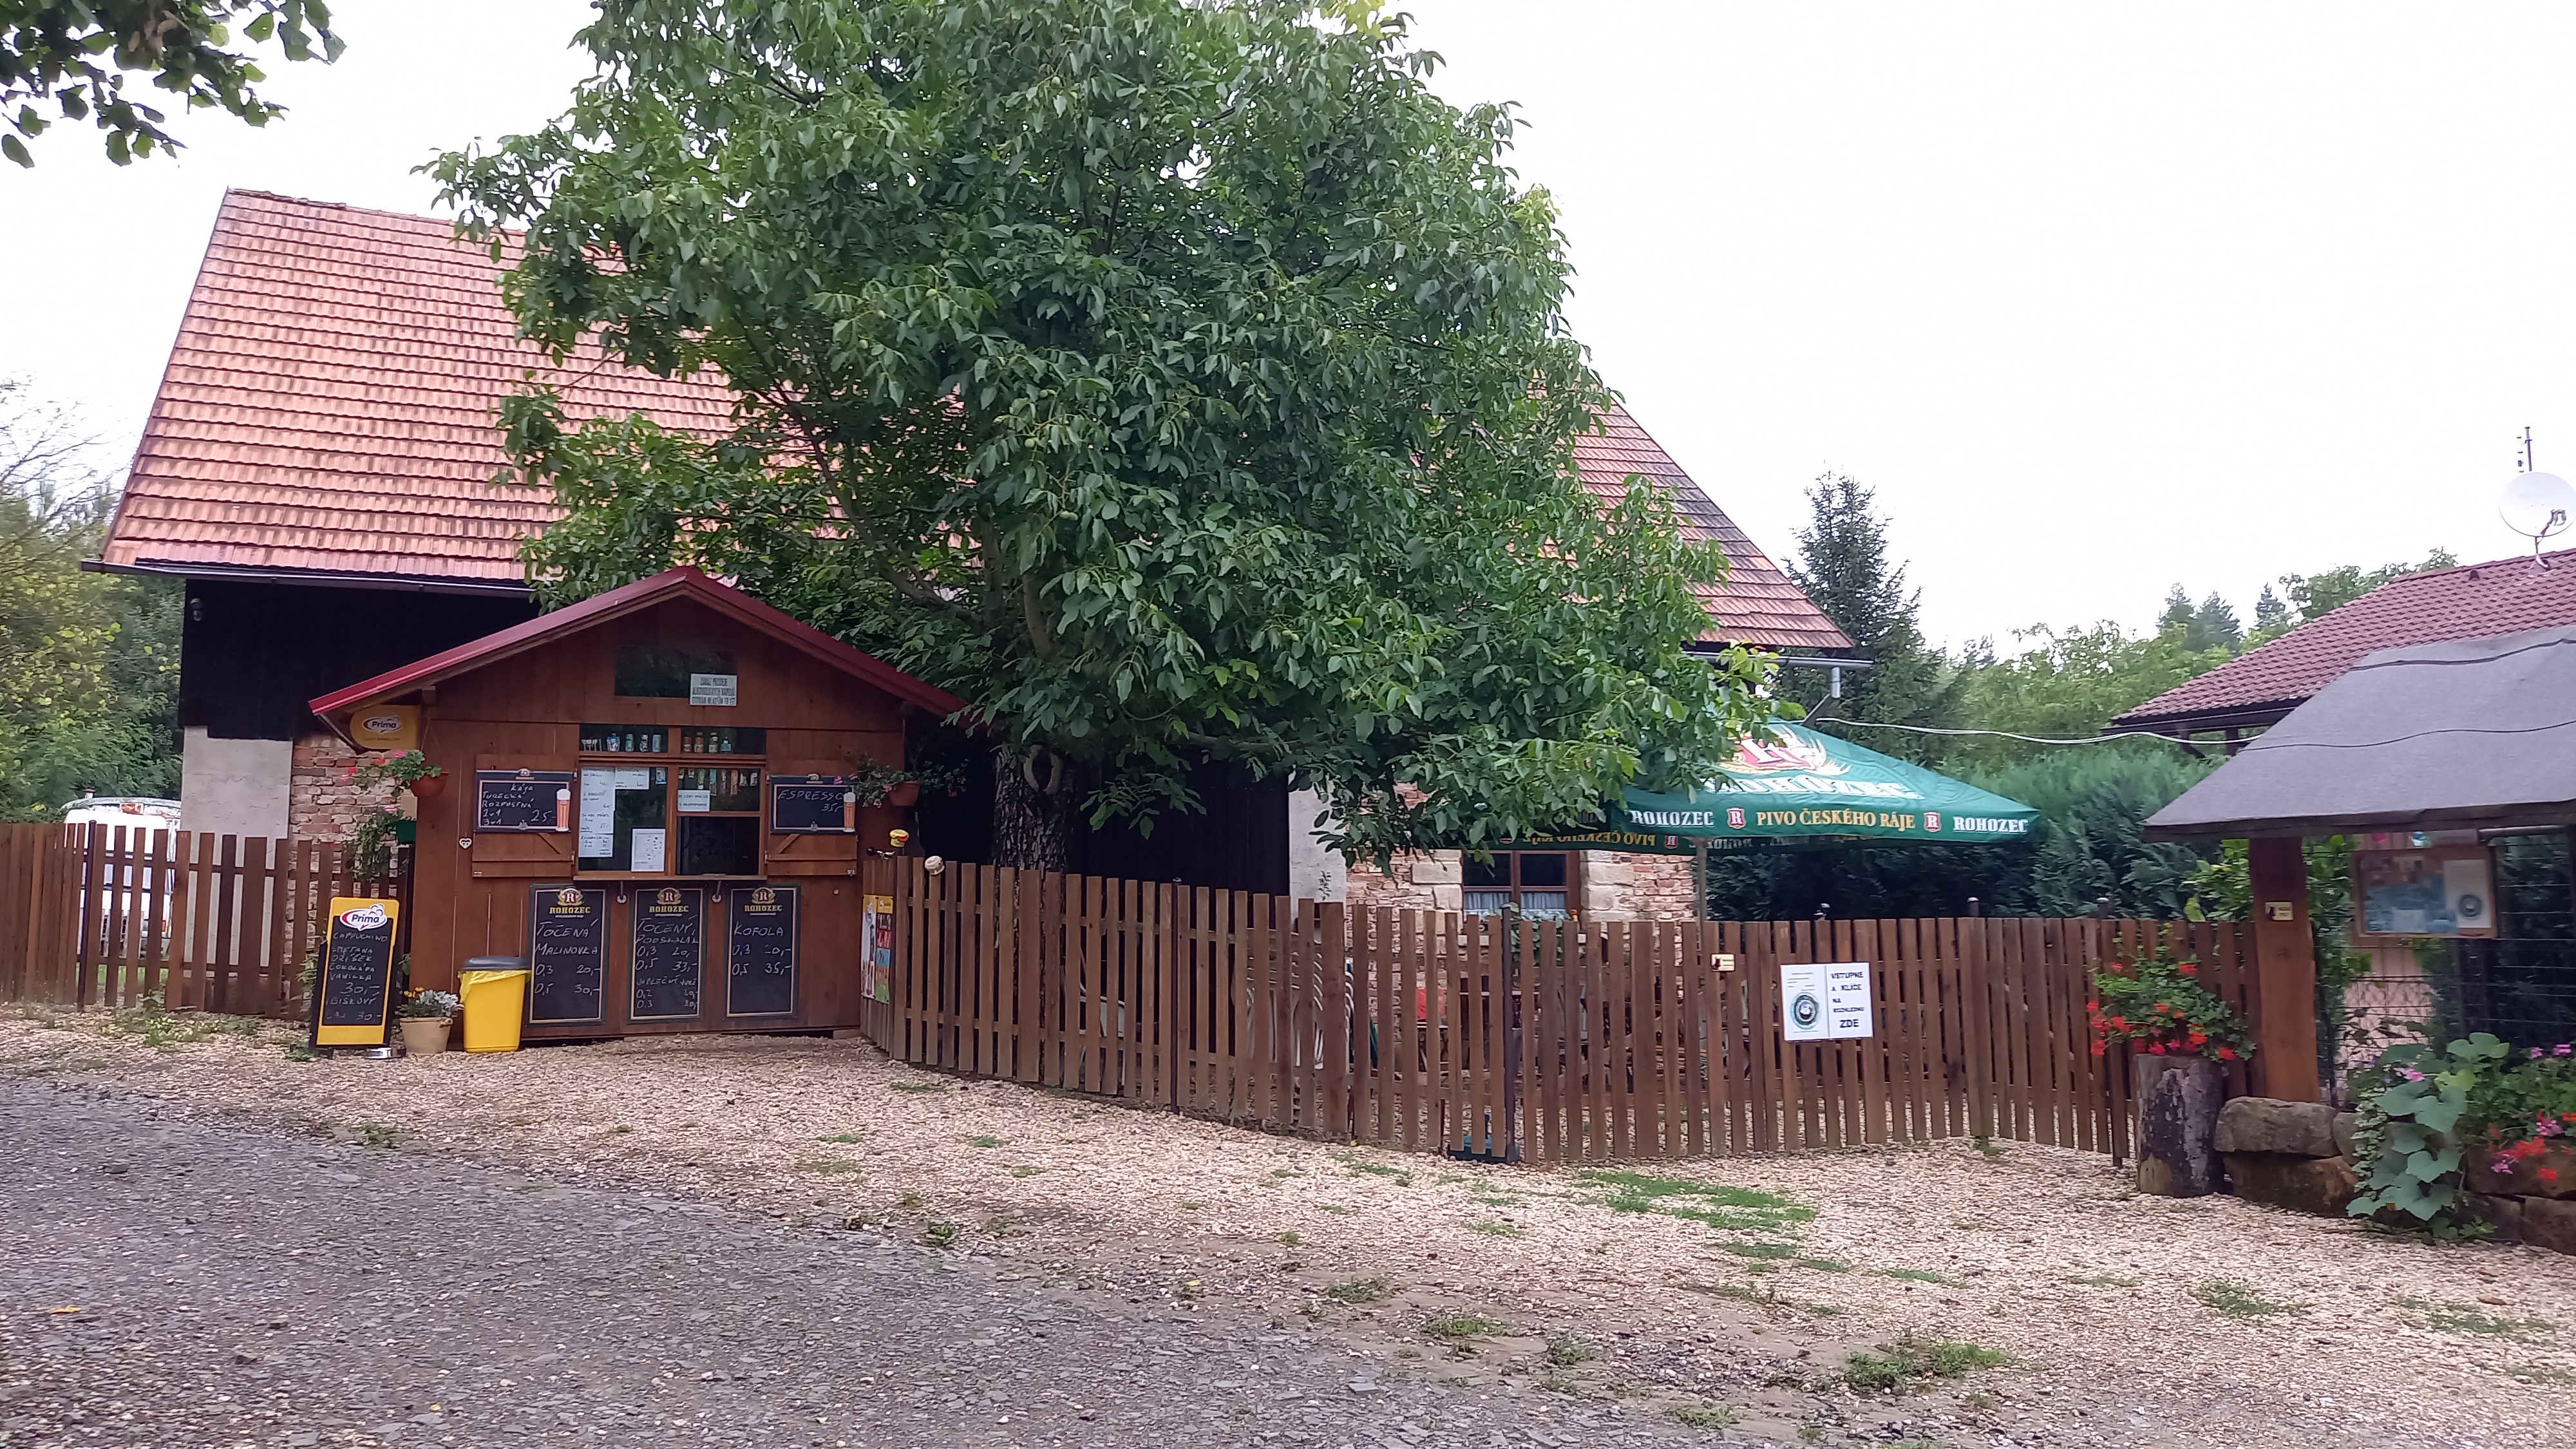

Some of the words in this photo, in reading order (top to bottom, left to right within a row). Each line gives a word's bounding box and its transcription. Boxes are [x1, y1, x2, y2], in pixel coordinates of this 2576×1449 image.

[777, 789, 844, 801] ESPRESSO
[1629, 809, 1716, 828] ROHOZEC
[1756, 810, 1797, 827] PIVO
[1799, 807, 1877, 828] ČESKÉHO
[1879, 811, 1916, 832] RÁJE
[1952, 816, 2029, 834] ROHOZEC
[351, 913, 380, 923] Prima
[536, 918, 599, 938] TOČENÁ
[734, 920, 784, 936] KOFOLA
[535, 942, 598, 956] MALINOVKA
[636, 945, 658, 957] 0,3
[732, 944, 750, 956] 0,3
[535, 963, 554, 976] 0,3
[635, 957, 659, 970] 0,5
[732, 963, 750, 976] 0,5
[636, 989, 653, 999] 0,2
[1839, 1019, 1859, 1028] ZDE
